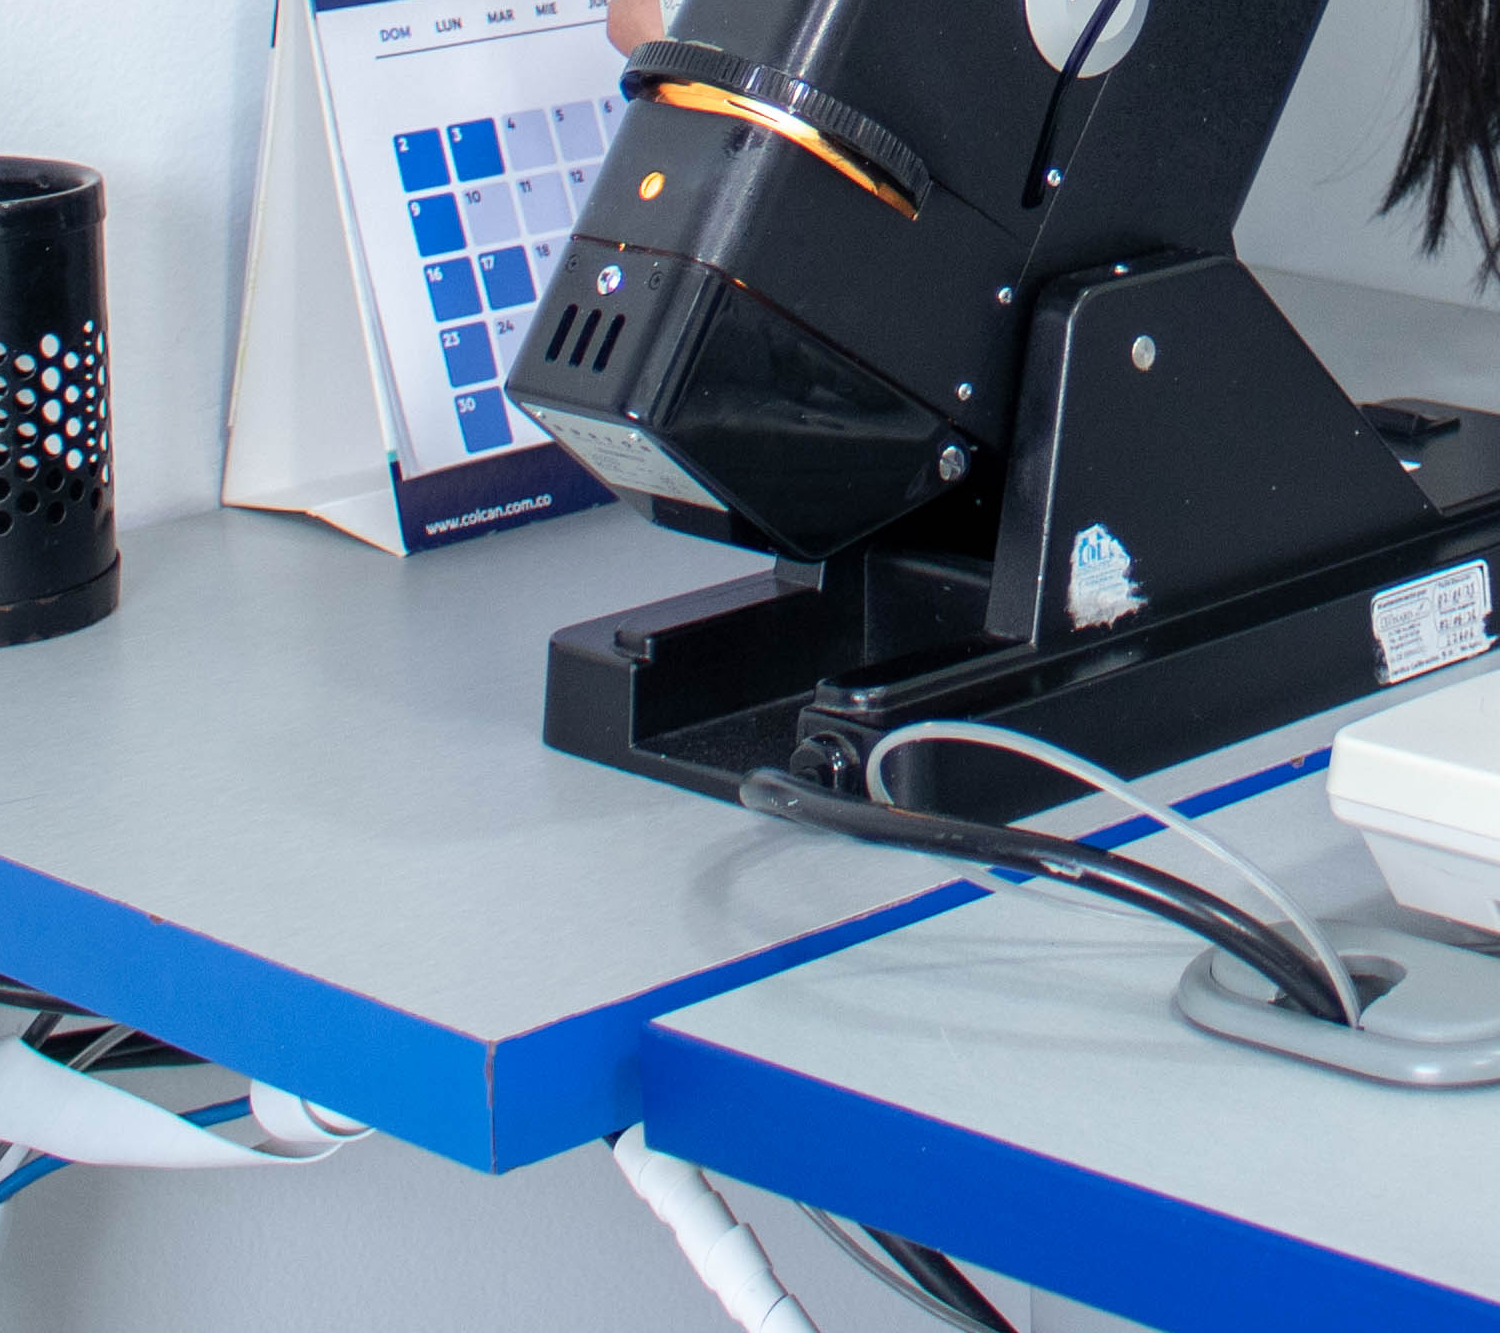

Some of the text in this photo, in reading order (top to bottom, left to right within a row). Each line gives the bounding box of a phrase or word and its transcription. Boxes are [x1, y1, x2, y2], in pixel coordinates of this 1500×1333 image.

[380, 25, 412, 42] DOM
[435, 17, 463, 33] LUN
[487, 7, 515, 25] MAR
[535, 1, 557, 17] MIE
[398, 101, 613, 152] 2 3 4 5 6
[411, 171, 584, 217] 9 10 11 12
[426, 244, 550, 283] 16 17 18
[443, 319, 514, 347] 23 24
[457, 396, 476, 413] 30
[425, 493, 553, 535] www.colcan.com.co
